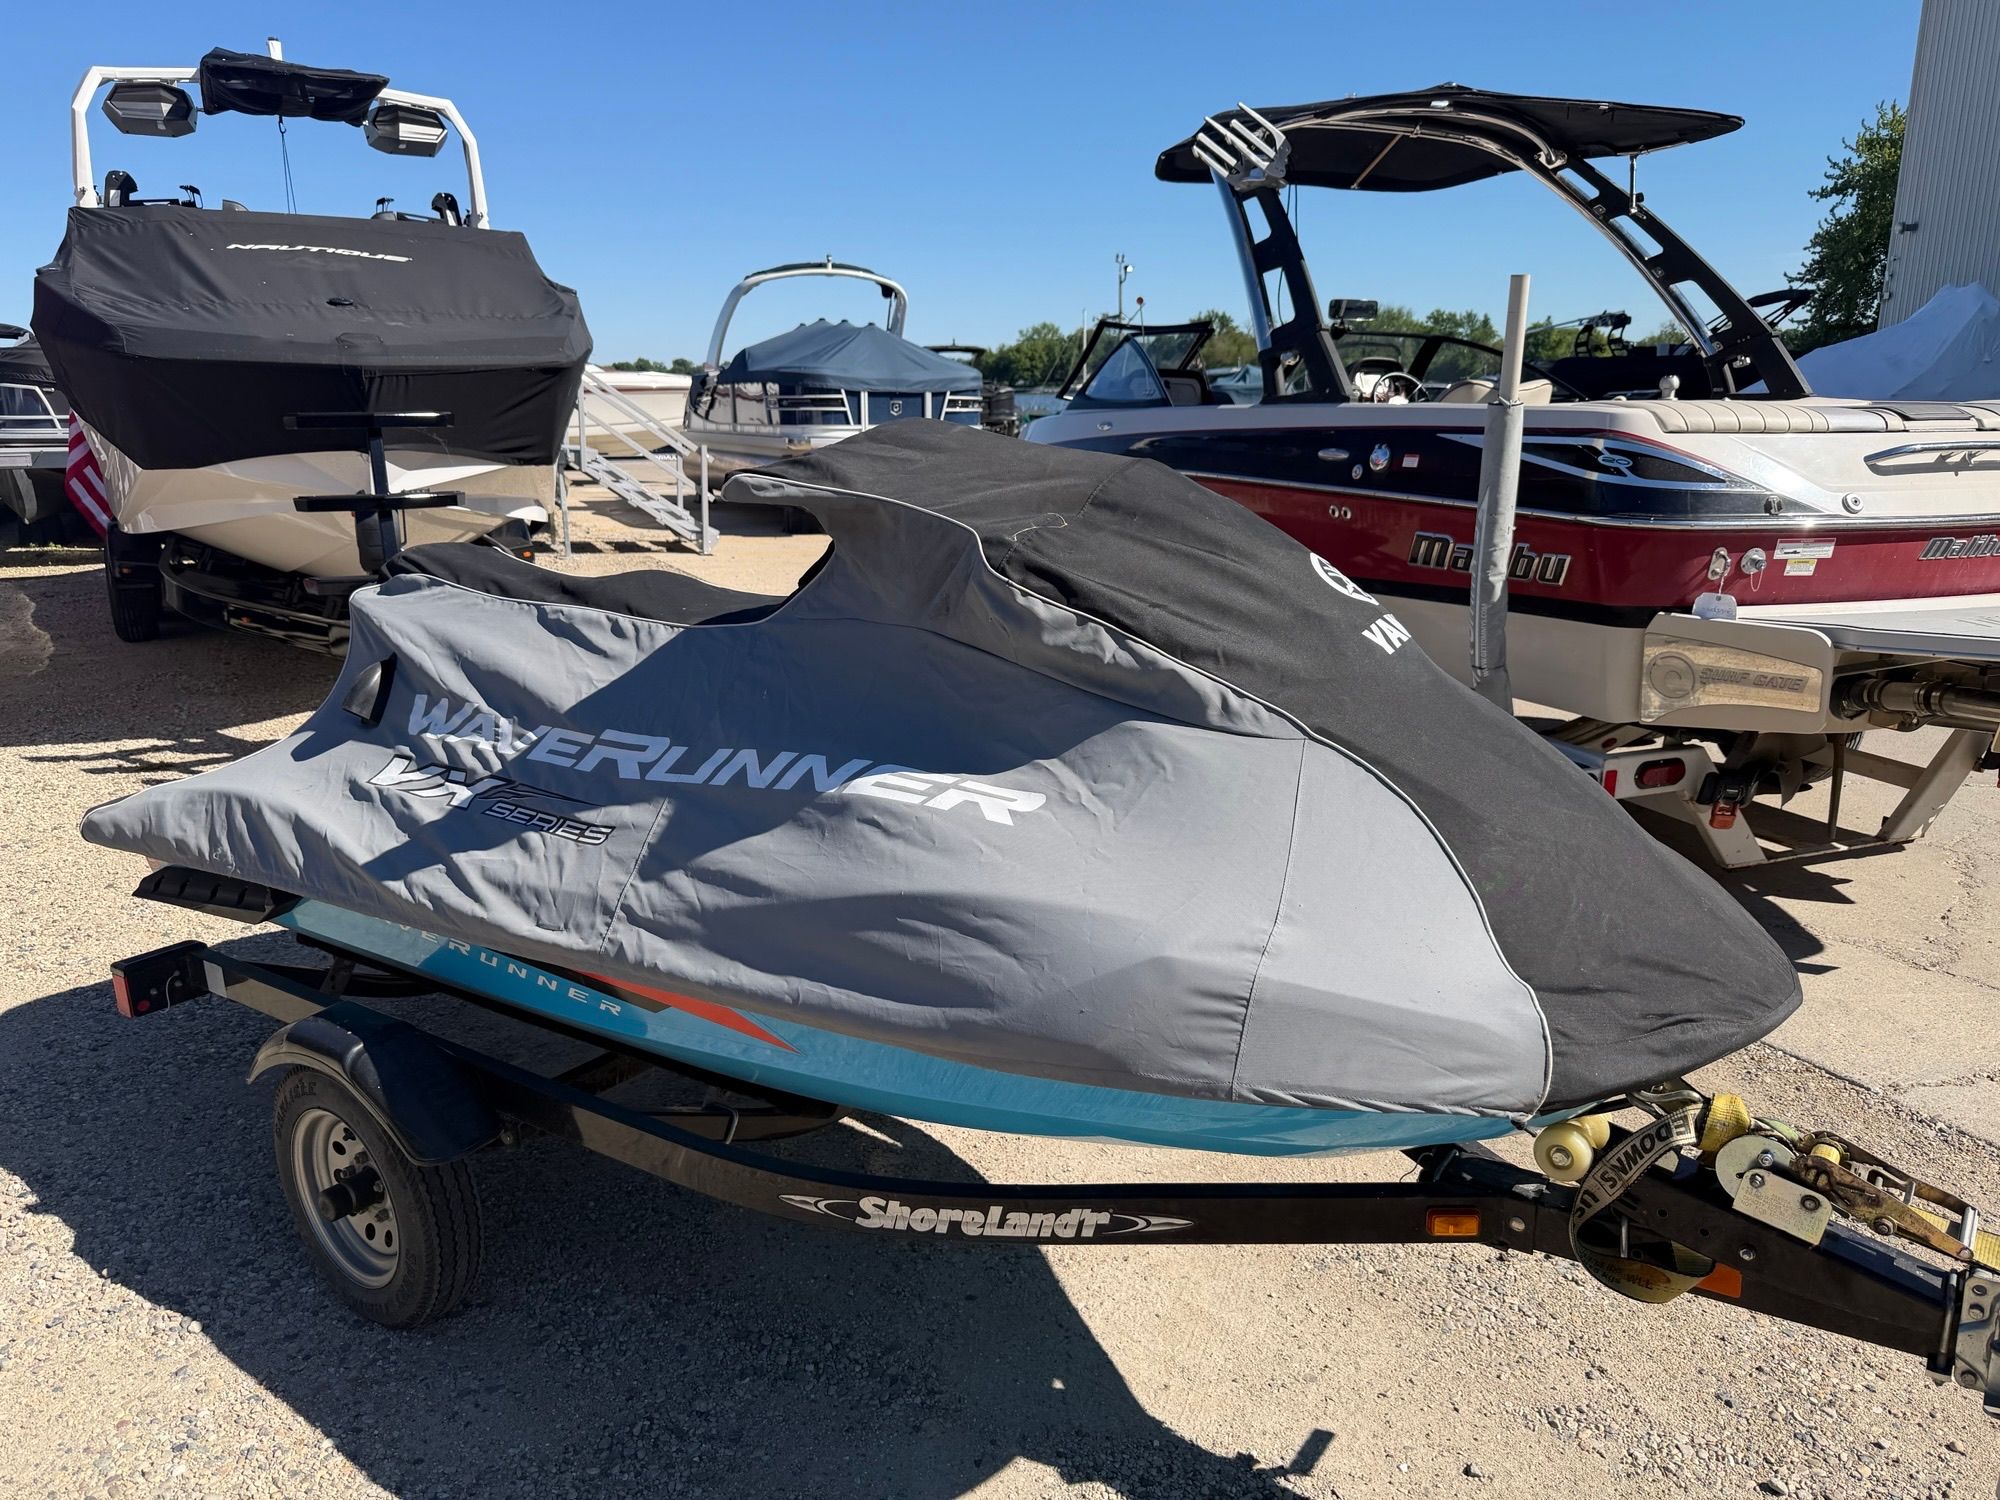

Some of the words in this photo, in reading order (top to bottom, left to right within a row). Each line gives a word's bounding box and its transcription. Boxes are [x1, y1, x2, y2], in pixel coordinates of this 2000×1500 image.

[226, 243, 411, 262] NAUTIQUE
[1407, 531, 1572, 587] Mabu
[1918, 533, 2000, 561] Malib
[1753, 674, 1804, 692] GATE
[408, 694, 1046, 826] WAVERUNNER
[485, 802, 613, 845] SERIES
